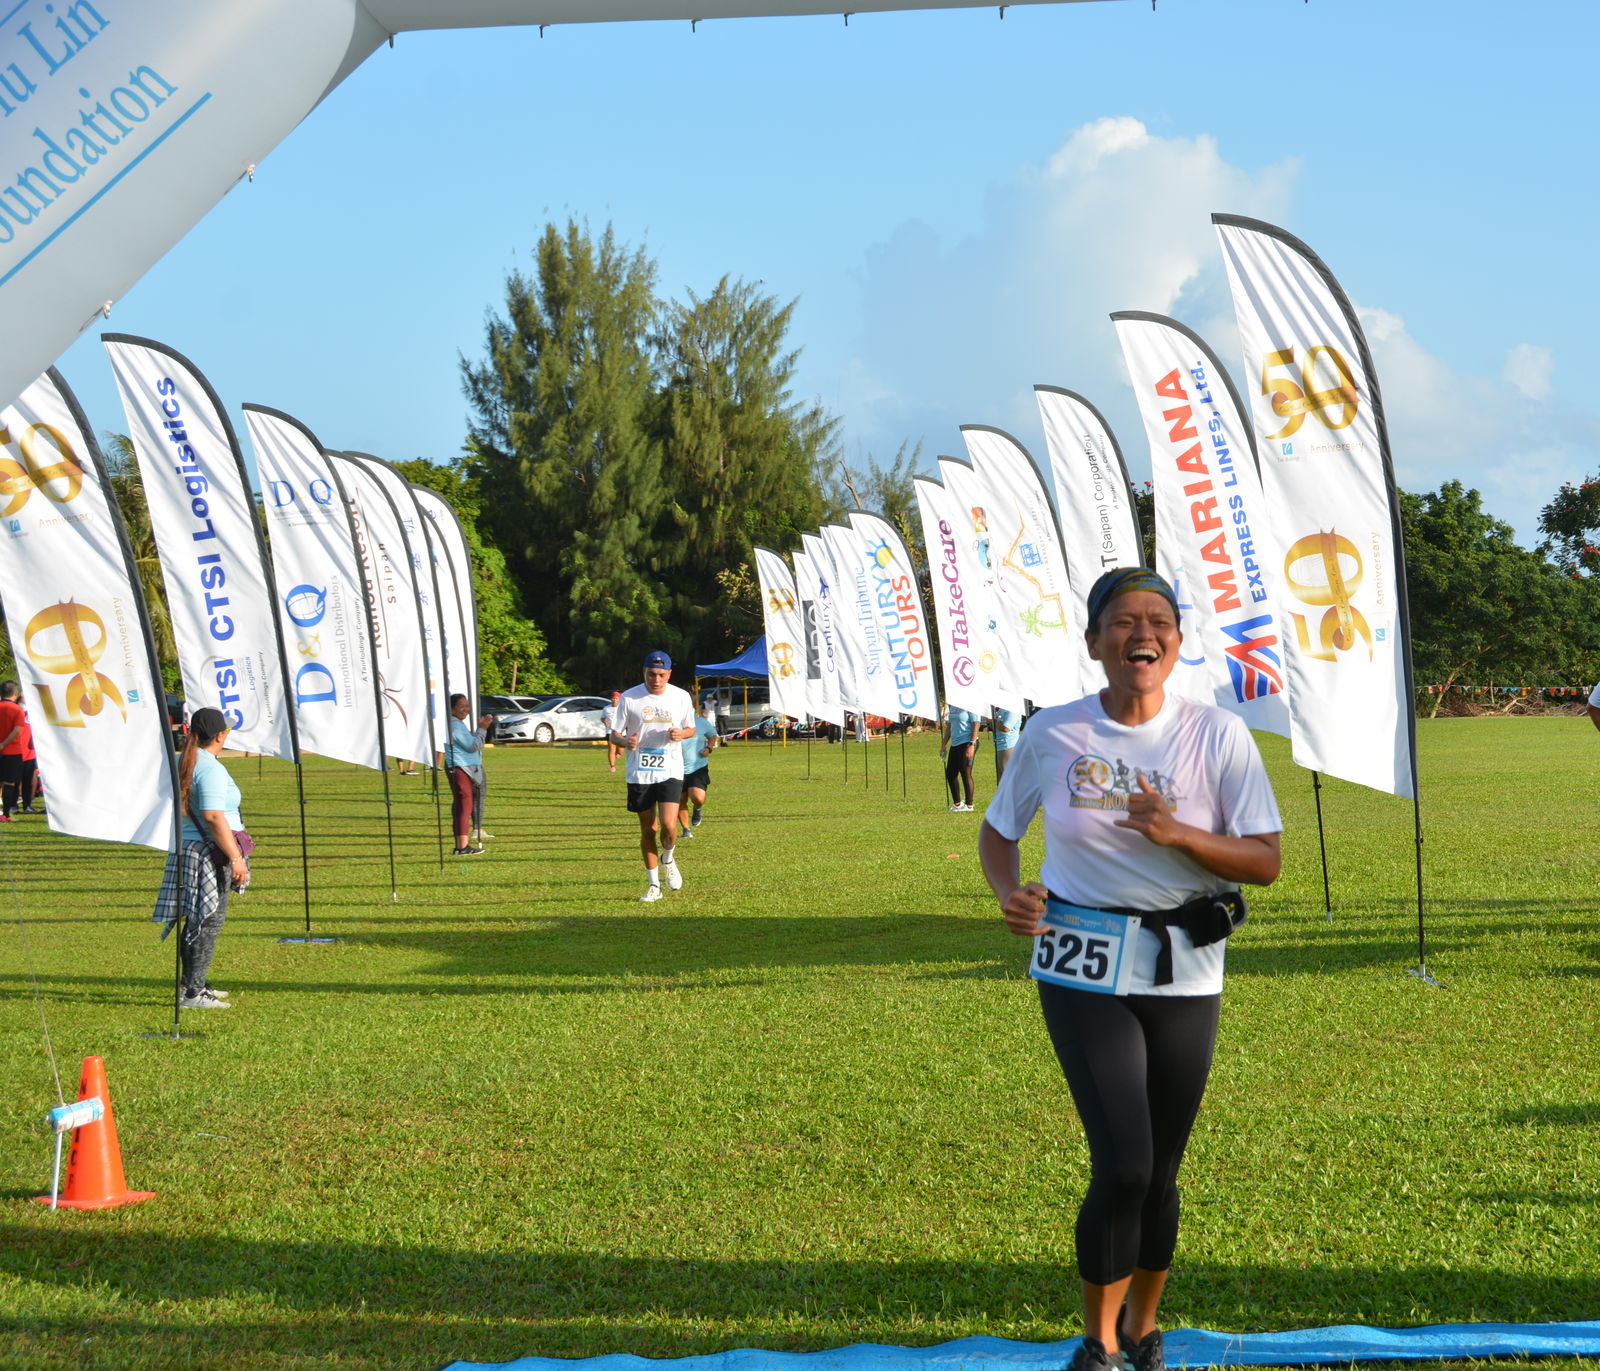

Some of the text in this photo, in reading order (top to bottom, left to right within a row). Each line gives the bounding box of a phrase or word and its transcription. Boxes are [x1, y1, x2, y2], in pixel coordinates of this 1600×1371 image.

[17, 0, 111, 77] Lin
[1261, 344, 1361, 439] 50
[156, 377, 235, 641] CTSI Logistics
[1083, 434, 1104, 501] Corporation
[1155, 368, 1242, 613] MARIANA
[1190, 361, 1268, 603] EXPRESS LINES, Ltd.
[1096, 504, 1116, 553] (Saipan)
[1371, 532, 1382, 606] Anniversary
[112, 597, 135, 669] Anniversary
[855, 566, 884, 678] Saipan Tribune
[891, 575, 928, 681] TOURS
[938, 519, 969, 651] TakeCare
[1284, 526, 1373, 662] 50
[24, 596, 128, 729] 50
[331, 575, 353, 708] International Distributors
[822, 602, 835, 673] Century
[875, 575, 918, 709] CENTURY
[213, 658, 244, 730] CTSI
[641, 755, 665, 768] 522
[1037, 929, 1110, 981] 525
